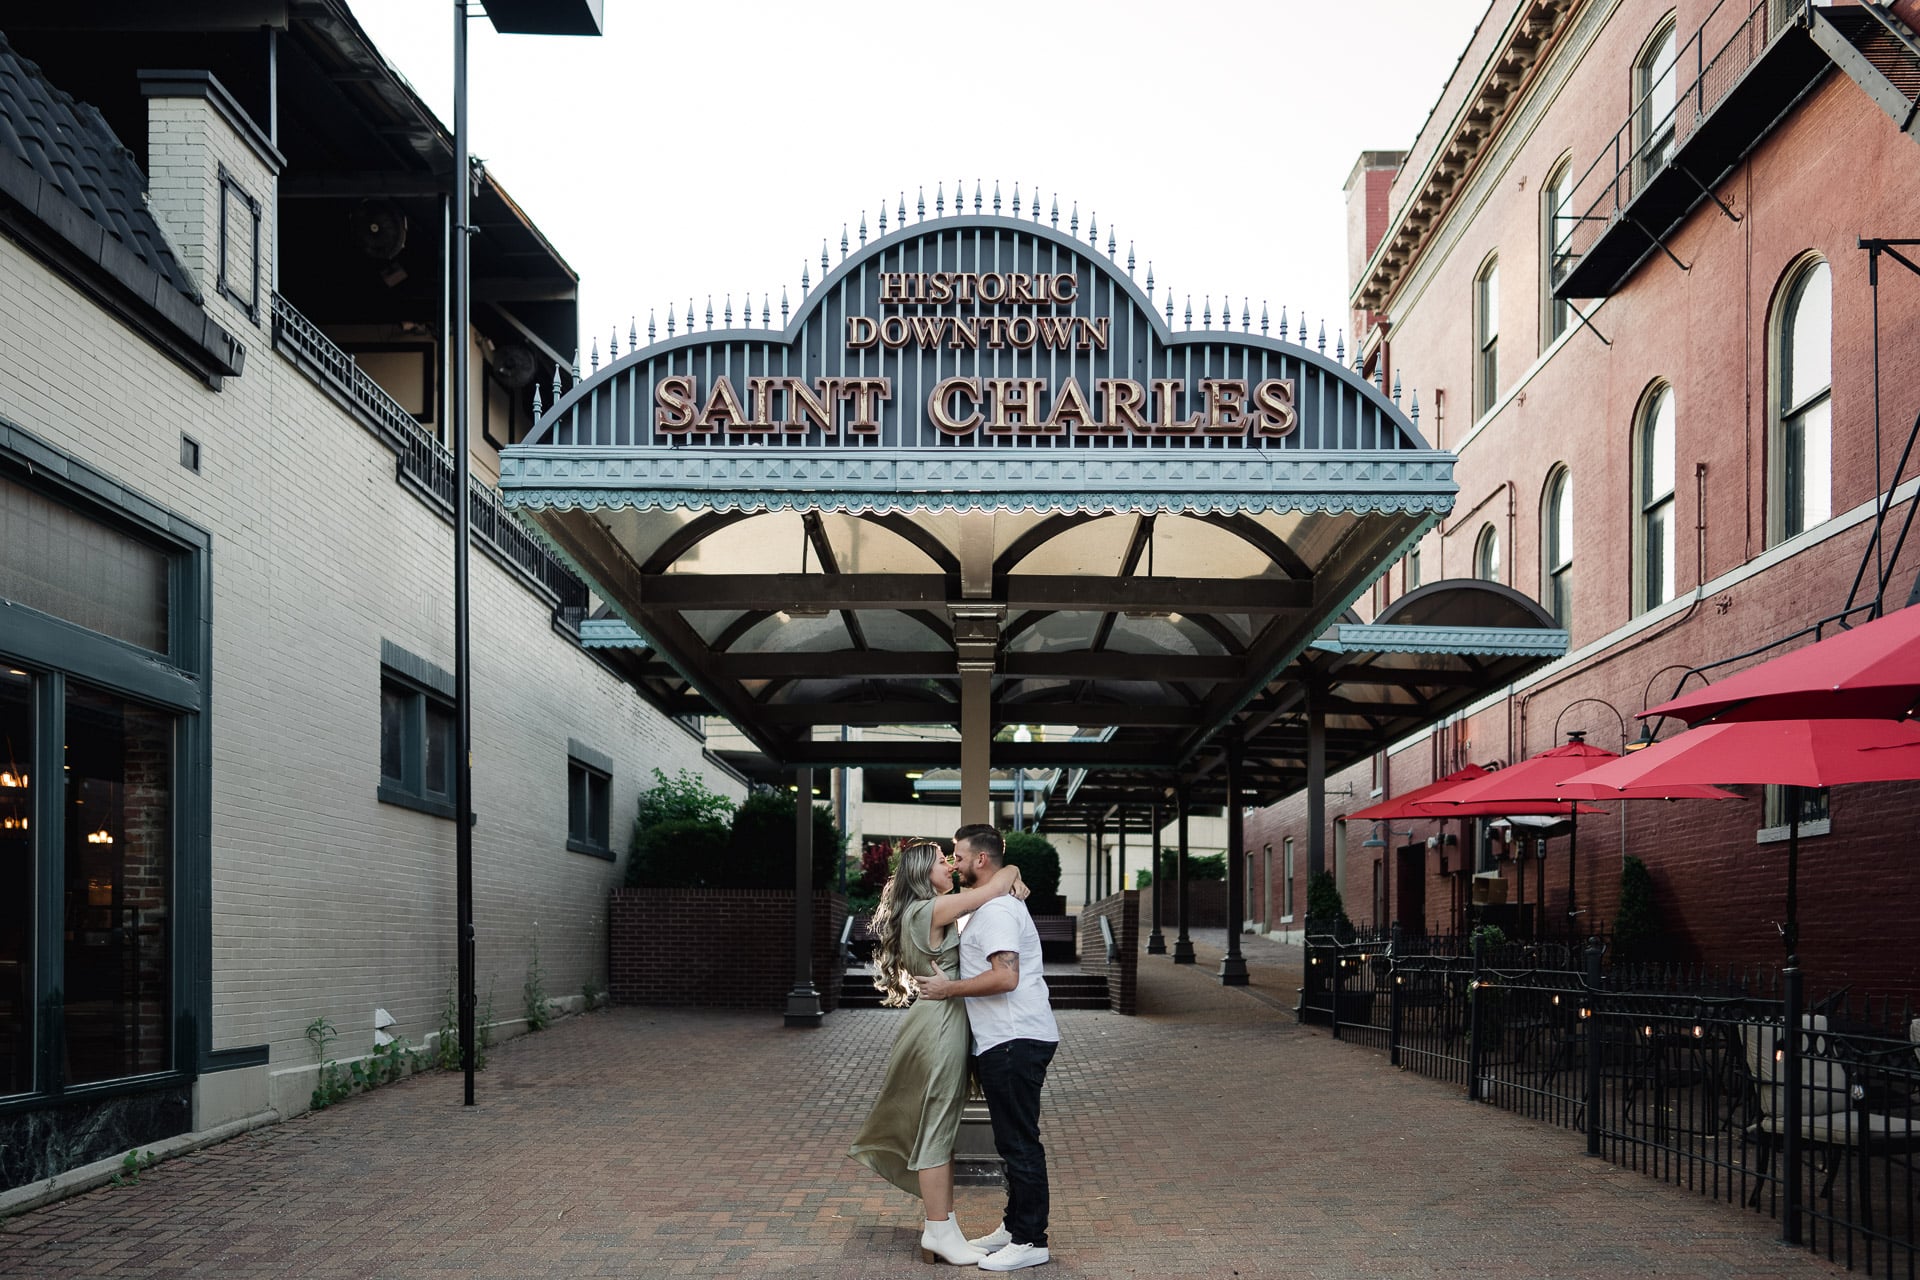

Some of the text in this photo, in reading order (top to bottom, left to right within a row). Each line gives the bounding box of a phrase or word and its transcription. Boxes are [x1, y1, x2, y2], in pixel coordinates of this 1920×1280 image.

[878, 272, 1079, 305] HISTORIC
[848, 315, 1109, 350] DOWNTOWN
[655, 376, 1298, 437] SAINT CHARLES
